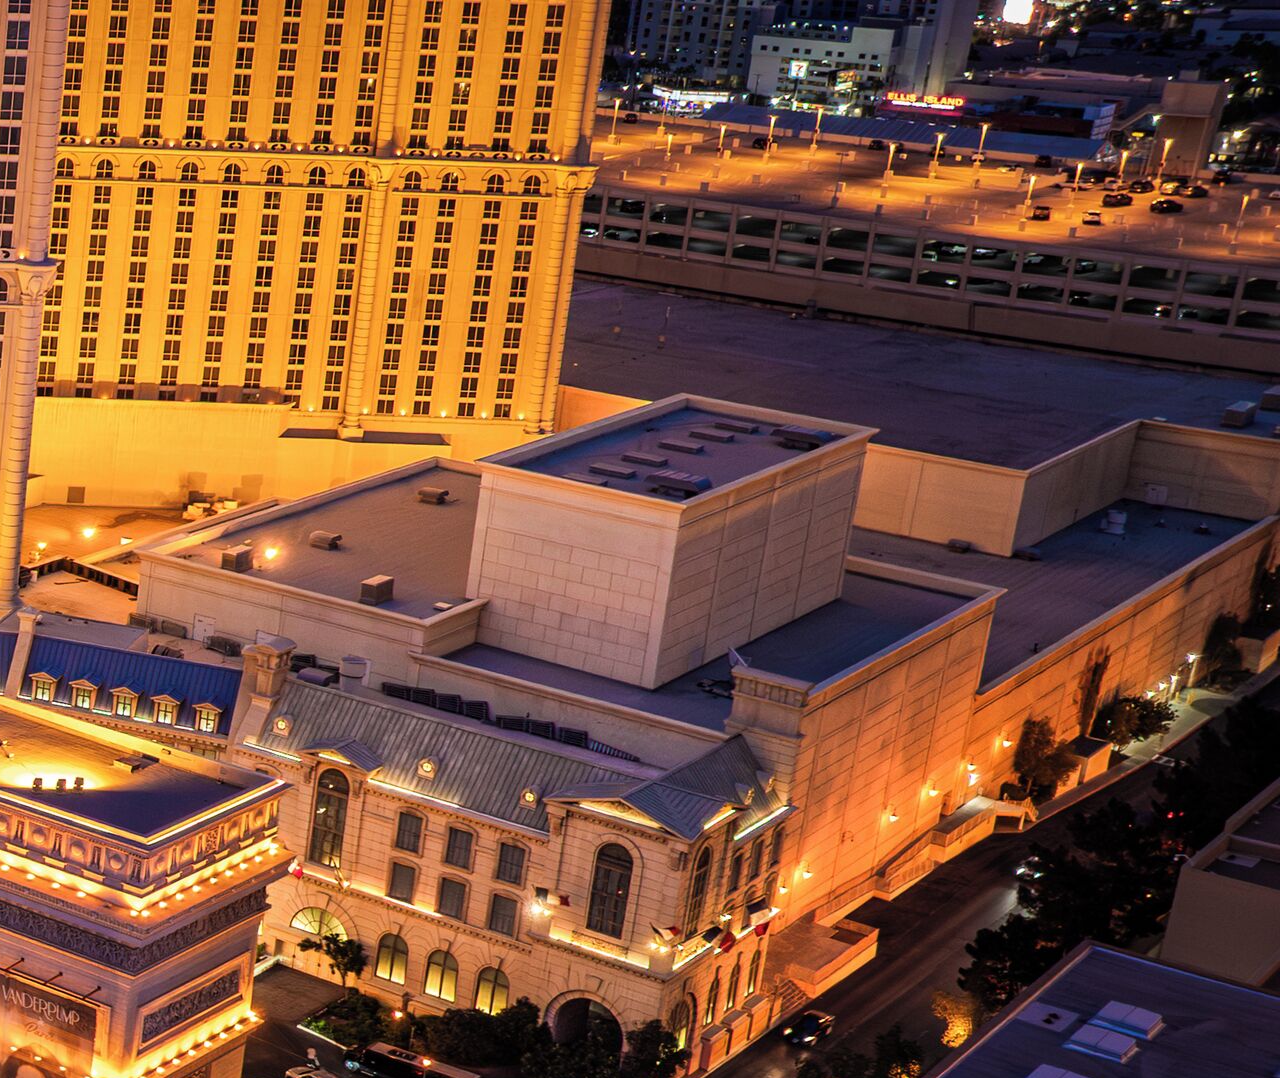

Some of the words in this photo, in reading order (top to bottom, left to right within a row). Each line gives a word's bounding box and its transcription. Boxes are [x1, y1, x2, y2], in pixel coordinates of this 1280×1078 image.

[887, 91, 917, 102] ELLIS
[923, 94, 965, 107] ISLAND
[1, 984, 80, 1026] VANDERPUMP
